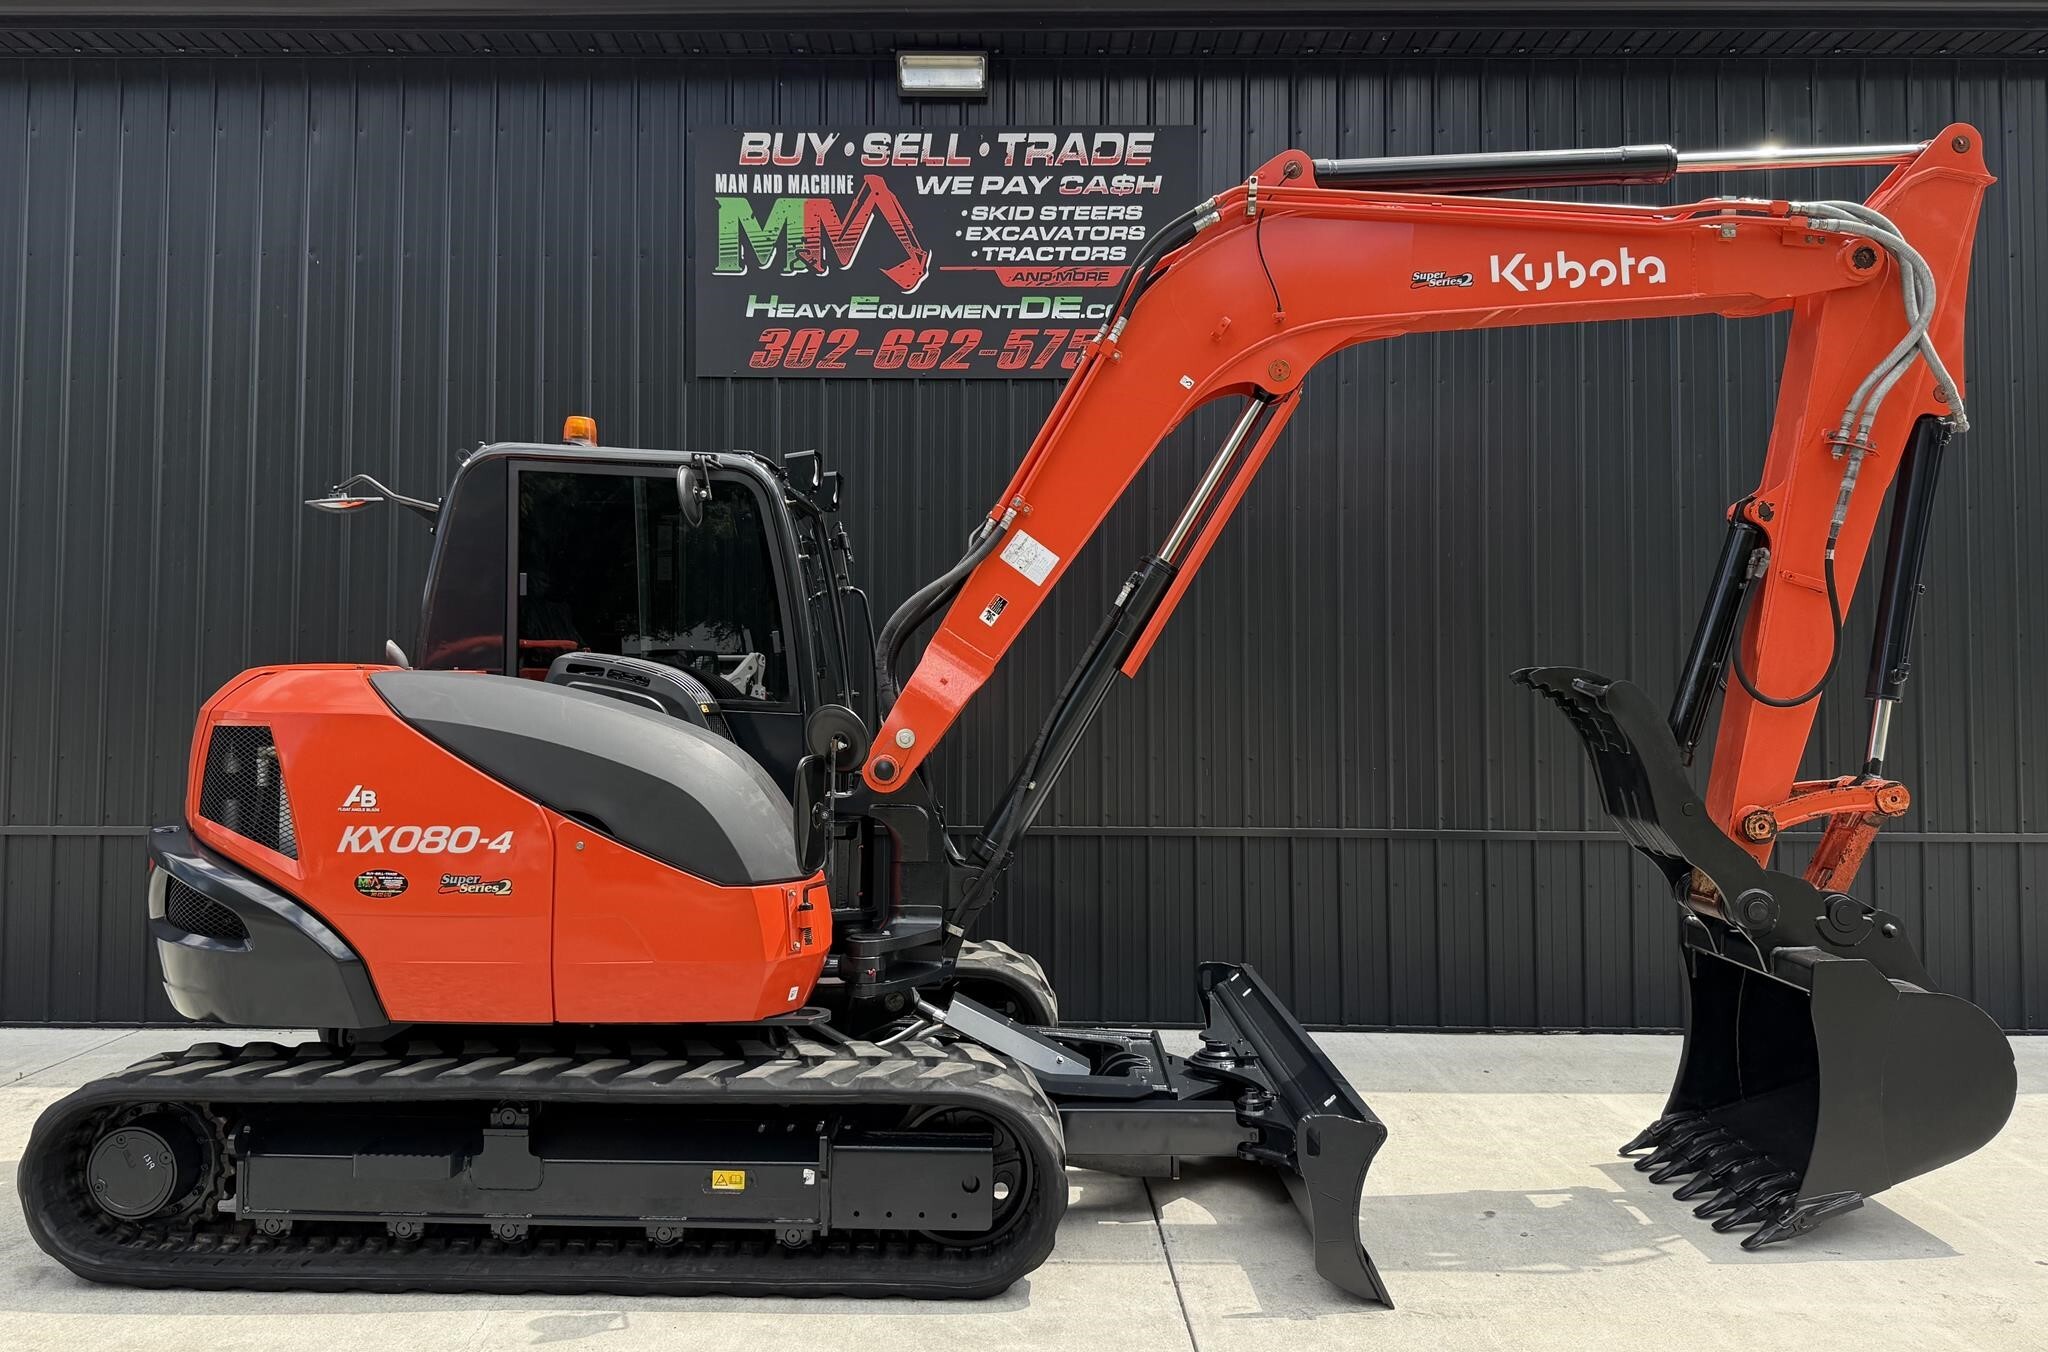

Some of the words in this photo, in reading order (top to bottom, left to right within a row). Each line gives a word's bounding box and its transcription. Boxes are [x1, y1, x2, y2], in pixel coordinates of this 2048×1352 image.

[739, 133, 840, 166] BUY
[861, 133, 971, 166] SELL
[997, 133, 1155, 167] TRADE
[715, 174, 748, 194] MAN
[753, 174, 782, 194] AND
[788, 174, 854, 194] MACHINE
[916, 175, 974, 195] WE
[980, 175, 1053, 195] PAY
[971, 206, 1034, 221] SKID
[1039, 206, 1143, 221] STEERS
[966, 226, 1146, 241] EXCAVATORS
[982, 247, 1126, 261] TRACTORS
[1412, 271, 1446, 282] Super
[1490, 247, 1666, 292] Kubota
[336, 825, 514, 854] KX080-4
[441, 873, 480, 886] Super
